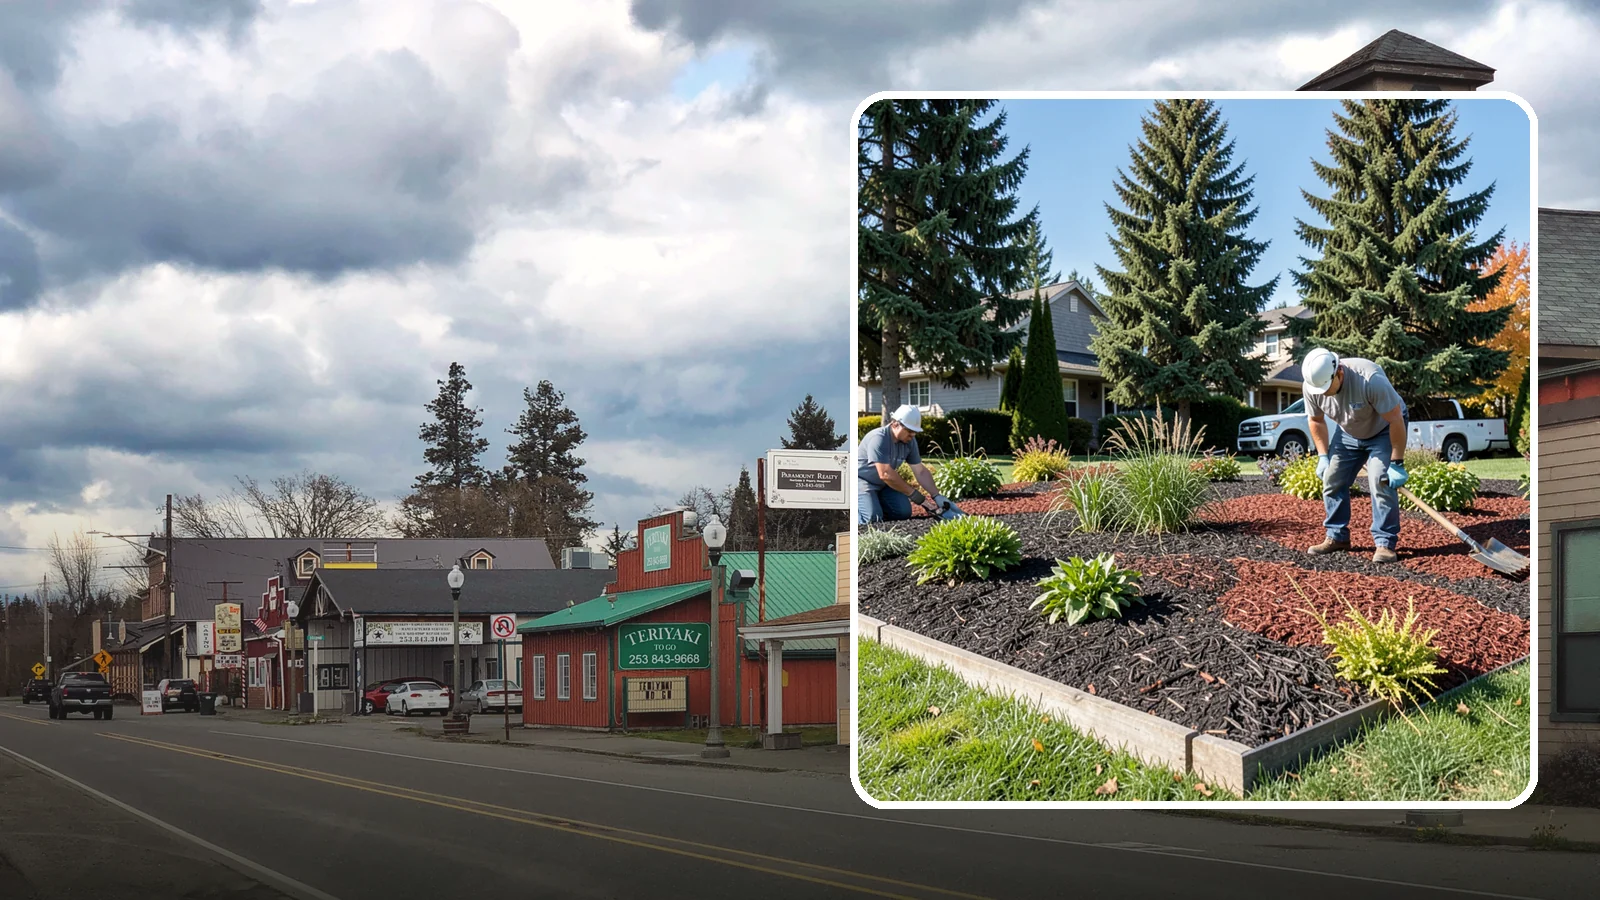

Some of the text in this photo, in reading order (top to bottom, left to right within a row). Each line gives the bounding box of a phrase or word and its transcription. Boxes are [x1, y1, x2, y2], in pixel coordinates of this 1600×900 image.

[781, 471, 839, 480] PARAMOUNT REALTY
[624, 627, 703, 646] TERIYAKI
[628, 653, 700, 664] 253 843-9668
[639, 681, 672, 691] TERIYAKI
